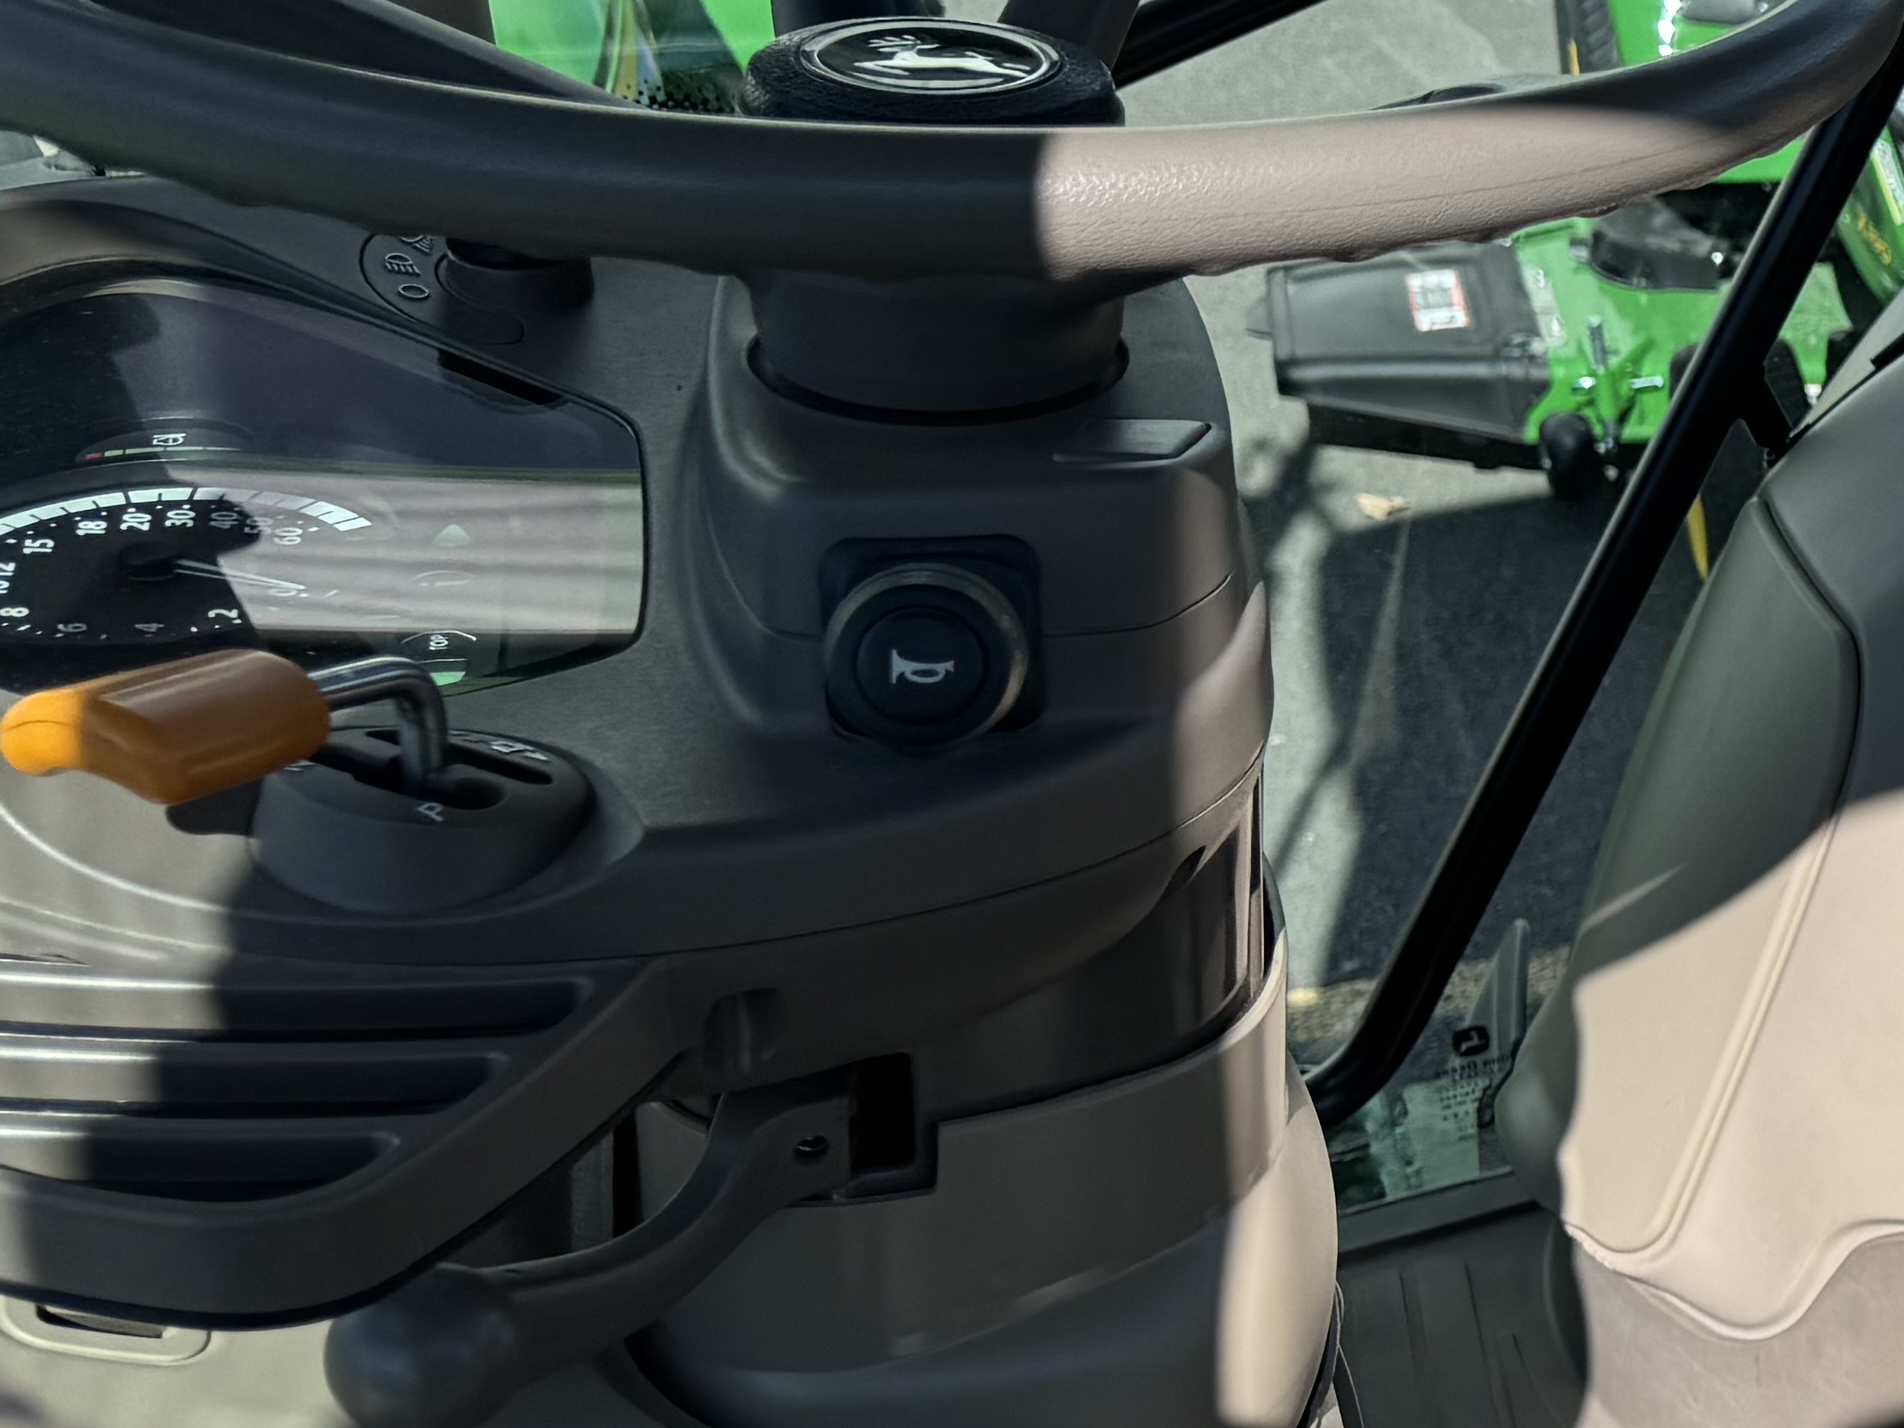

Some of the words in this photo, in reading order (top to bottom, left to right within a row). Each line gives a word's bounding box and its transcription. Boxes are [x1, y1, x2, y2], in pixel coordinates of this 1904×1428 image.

[120, 513, 152, 531] 20
[165, 510, 195, 528] 30
[209, 511, 239, 529] 40
[244, 517, 274, 534] 50
[75, 520, 107, 536] 18
[273, 527, 303, 545] 60
[23, 538, 55, 554] 15
[0, 607, 30, 618] 8
[208, 608, 239, 619] 2
[58, 622, 88, 633] 6
[134, 622, 165, 632] 4
[417, 802, 444, 822] P
